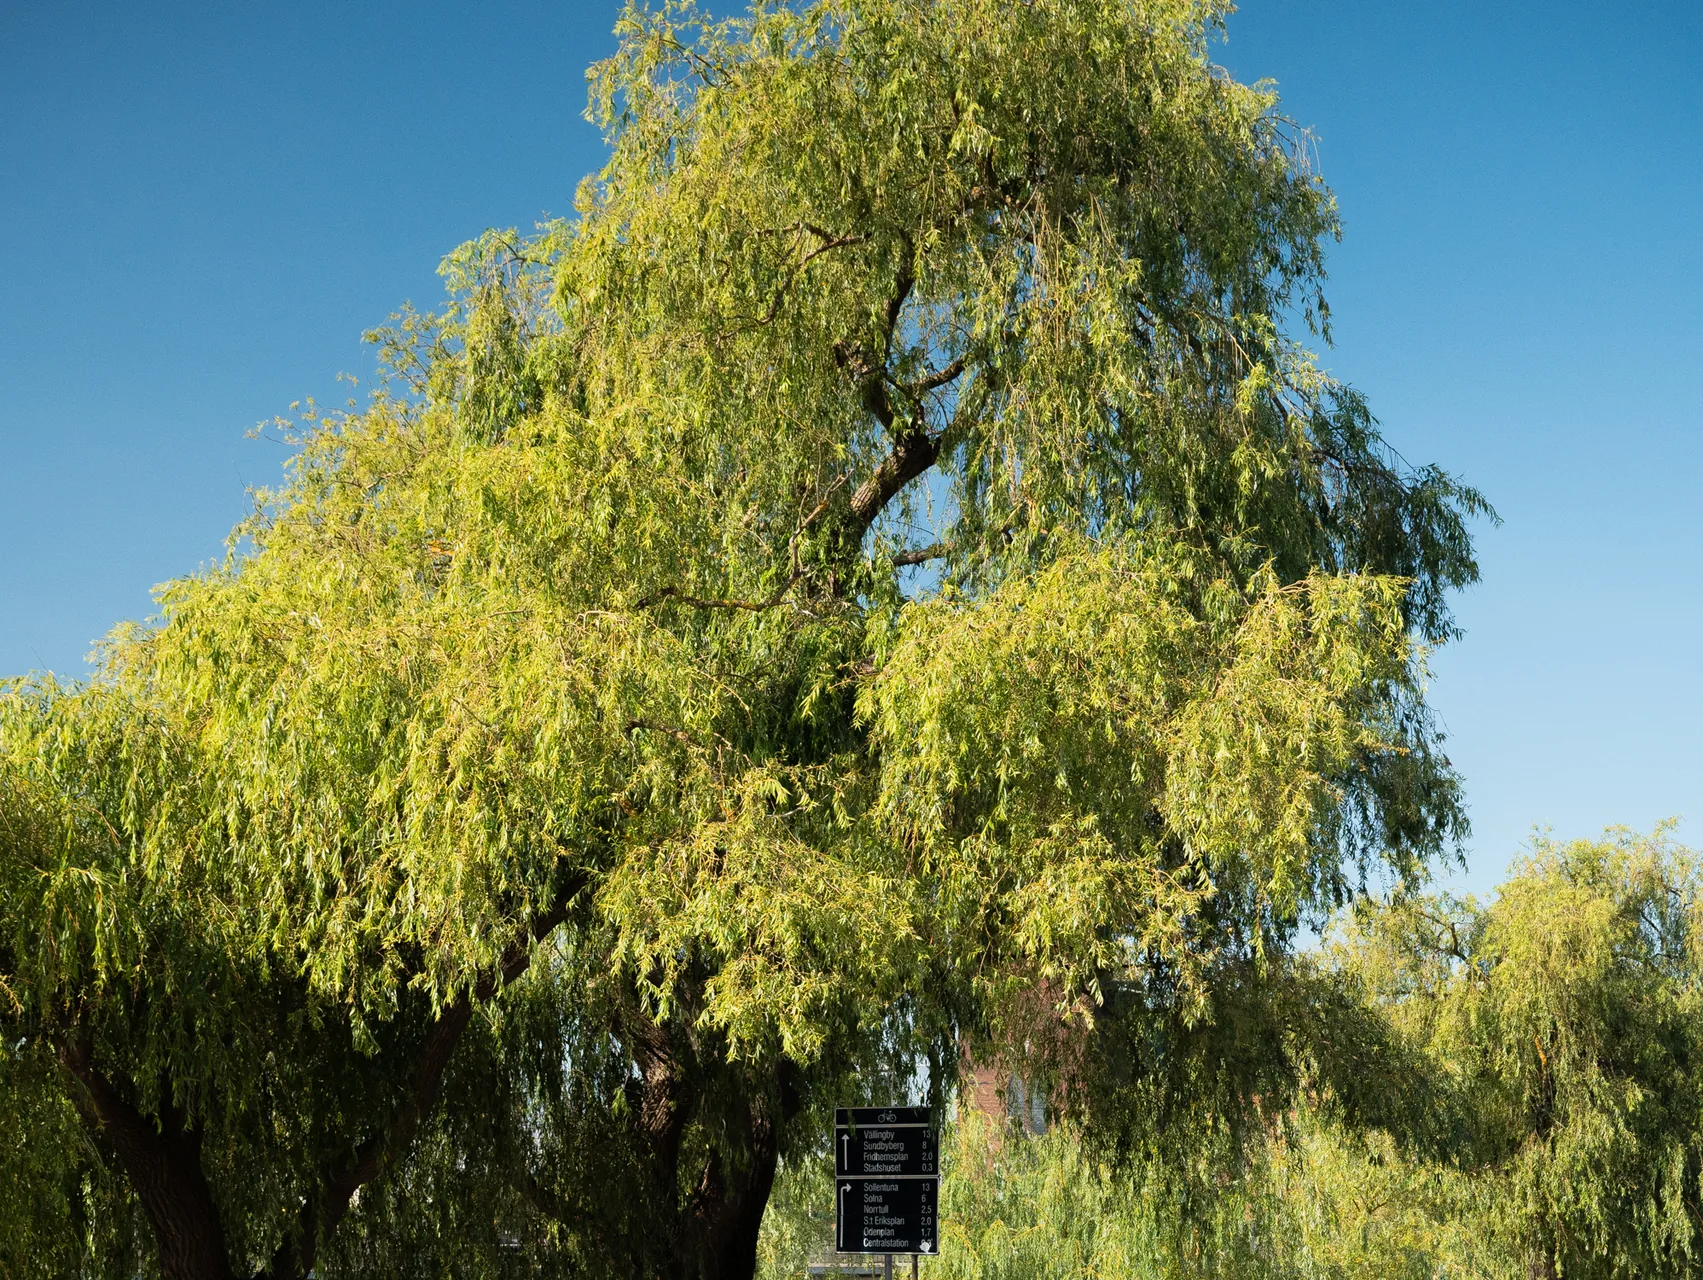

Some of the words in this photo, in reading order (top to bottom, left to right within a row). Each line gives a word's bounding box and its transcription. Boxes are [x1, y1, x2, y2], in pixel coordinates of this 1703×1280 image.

[922, 1130, 931, 1138] 13
[864, 1141, 904, 1151] Sundbyberg
[922, 1141, 927, 1149] 8
[864, 1152, 908, 1162] Fridhemsplan
[864, 1163, 901, 1172] Stadshuset
[864, 1183, 899, 1192] Sollentuna
[922, 1183, 930, 1191] 13
[864, 1194, 883, 1203] Solna
[921, 1194, 926, 1203] 6
[864, 1205, 889, 1213] Norrtull
[875, 1216, 905, 1226] Eriksplan
[864, 1227, 895, 1237] Odenplan
[863, 1238, 909, 1247] Centralstation
